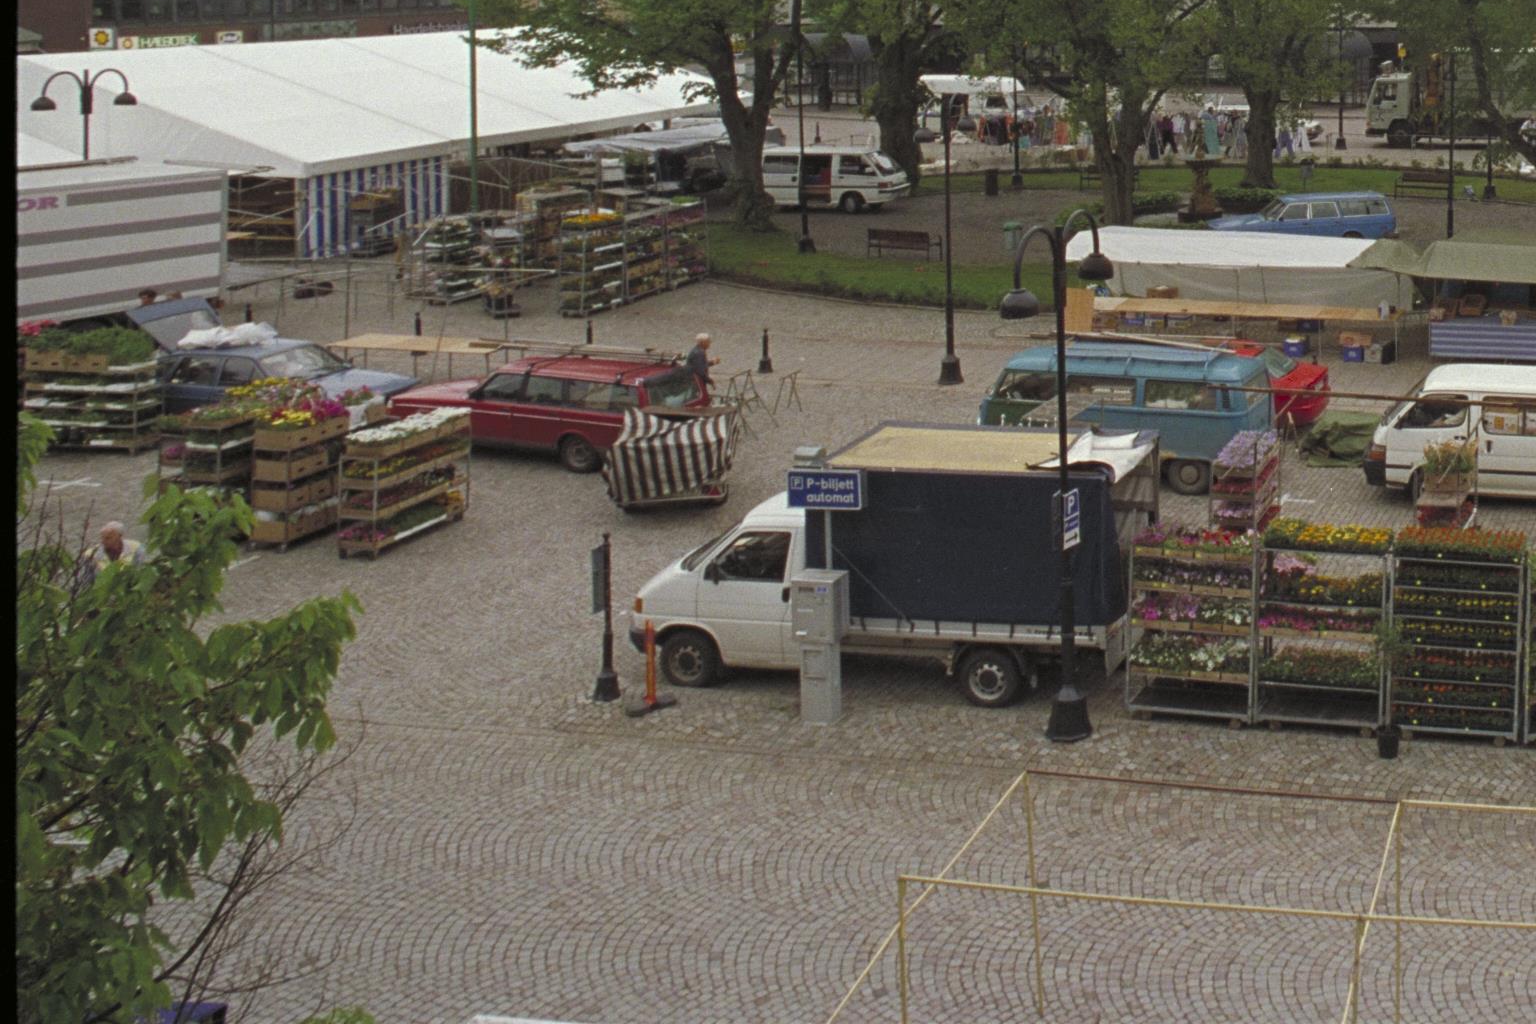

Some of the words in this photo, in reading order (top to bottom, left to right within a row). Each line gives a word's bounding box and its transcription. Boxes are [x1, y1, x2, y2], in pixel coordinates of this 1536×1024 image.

[806, 477, 854, 491] P-biljett
[806, 493, 854, 504] automat
[1067, 494, 1075, 515] P
